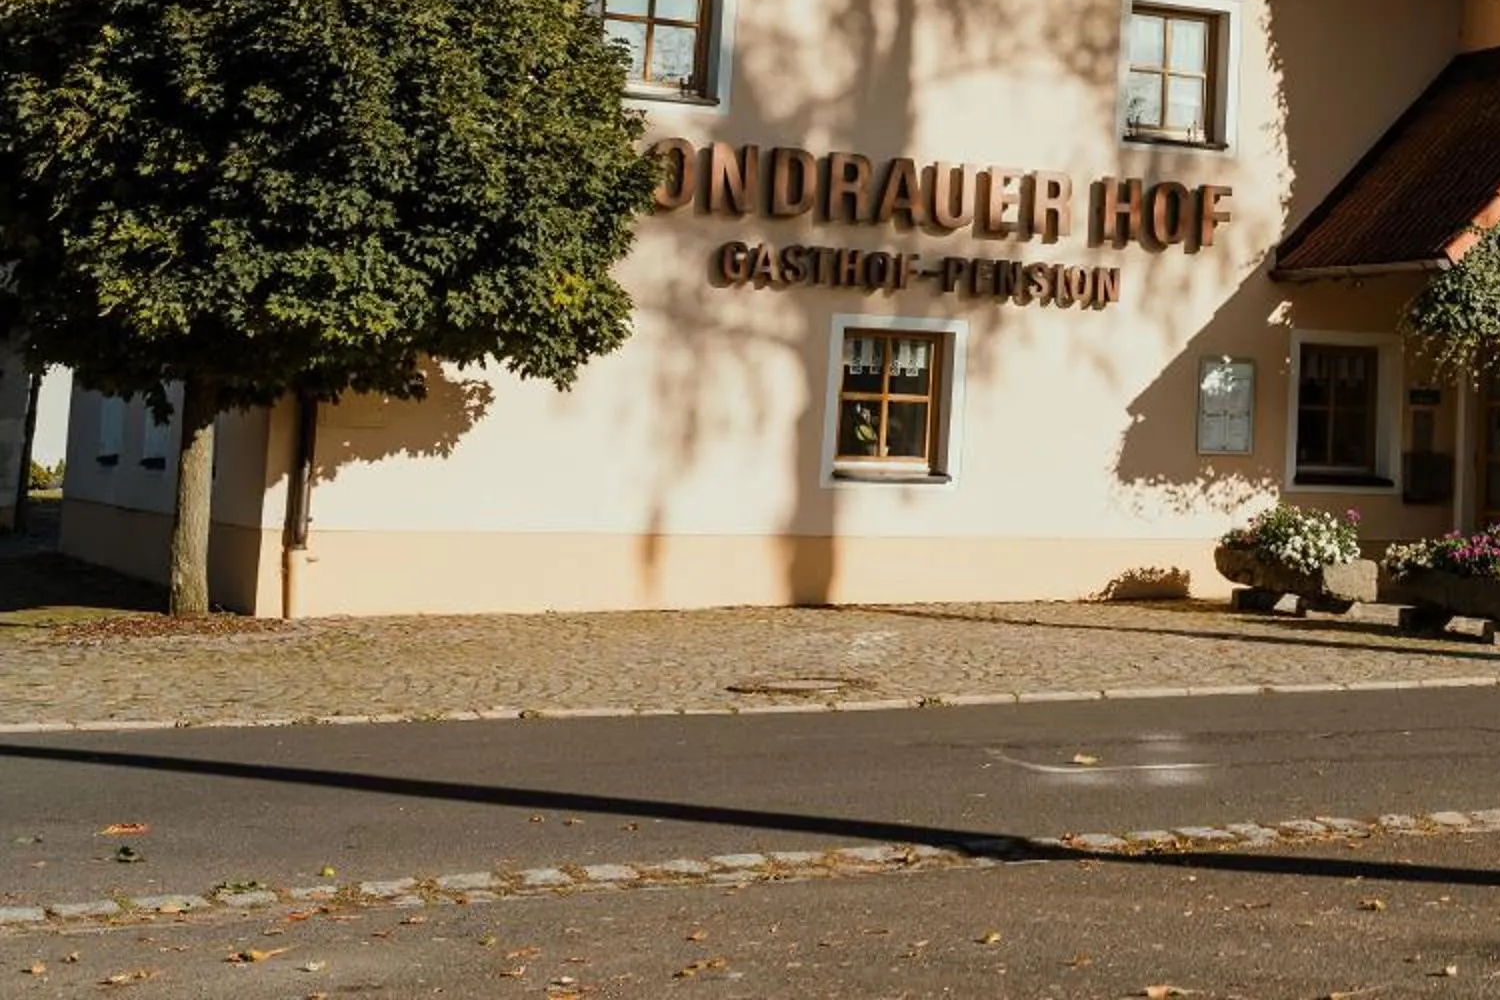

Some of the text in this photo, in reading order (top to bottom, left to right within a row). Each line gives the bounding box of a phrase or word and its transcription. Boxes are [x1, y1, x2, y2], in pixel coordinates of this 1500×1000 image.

[650, 137, 1233, 248] ONDRAUER HOF
[716, 241, 1120, 304] GASTHOF-PENSION
